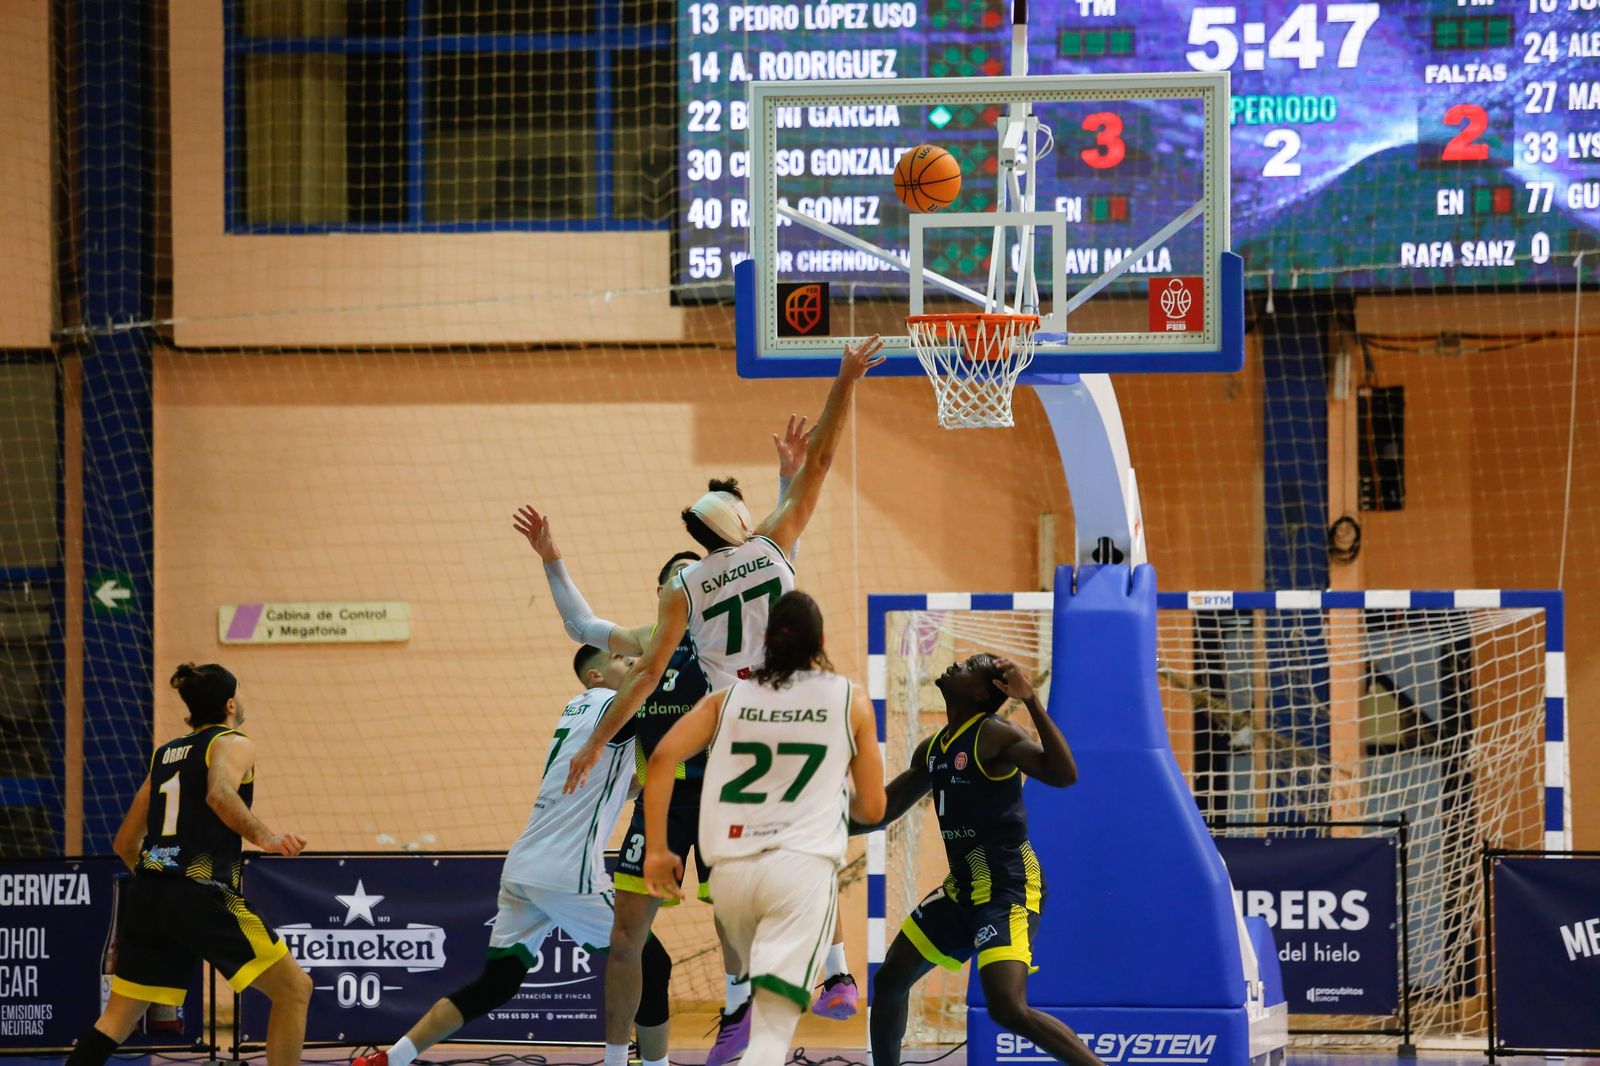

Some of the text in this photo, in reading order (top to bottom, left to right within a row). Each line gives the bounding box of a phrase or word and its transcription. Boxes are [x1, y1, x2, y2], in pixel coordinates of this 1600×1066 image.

[688, 0, 917, 34] 13 PEDRO LÓPEZ USO
[1075, 0, 1118, 17] TM
[1186, 3, 1380, 71] 5:47
[1524, 31, 1558, 63] 24
[688, 49, 898, 83] 14 A. RODRIGUEZ
[1424, 63, 1508, 83] FALTAS
[1230, 94, 1336, 124] PERIODO
[1525, 81, 1557, 113] 27
[687, 101, 721, 131] 22
[1081, 111, 1126, 169] 3
[1442, 104, 1489, 161] 2
[1262, 129, 1301, 177] 2
[1524, 132, 1558, 164] 33
[687, 149, 721, 181] 30
[687, 198, 722, 229] 40
[798, 196, 880, 225] GOMEZ
[1437, 189, 1464, 216] EN
[1525, 183, 1555, 214] 77
[688, 247, 722, 279] 55
[1065, 247, 1099, 274] AVI
[1401, 232, 1550, 267] RAFA SANZ 0
[1166, 323, 1187, 331] FEB
[266, 608, 387, 622] Cabina de Control
[1204, 596, 1231, 606] RTM
[267, 628, 274, 638] y
[663, 669, 680, 692] 3
[738, 707, 828, 723] IGLESIAS
[719, 741, 828, 804] 27
[159, 771, 180, 837] 1
[625, 833, 645, 863] 3
[0, 873, 91, 906] CERVEZA
[1233, 890, 1370, 930] BERS
[283, 934, 435, 960] Heineken
[1278, 942, 1361, 962] del hielo
[337, 972, 381, 1008] 0.0
[1315, 987, 1364, 997] procubitos
[1, 1004, 53, 1020] EMISIONES
[555, 1012, 598, 1020] www.edir.es
[1, 1020, 44, 1036] NEUTRAS
